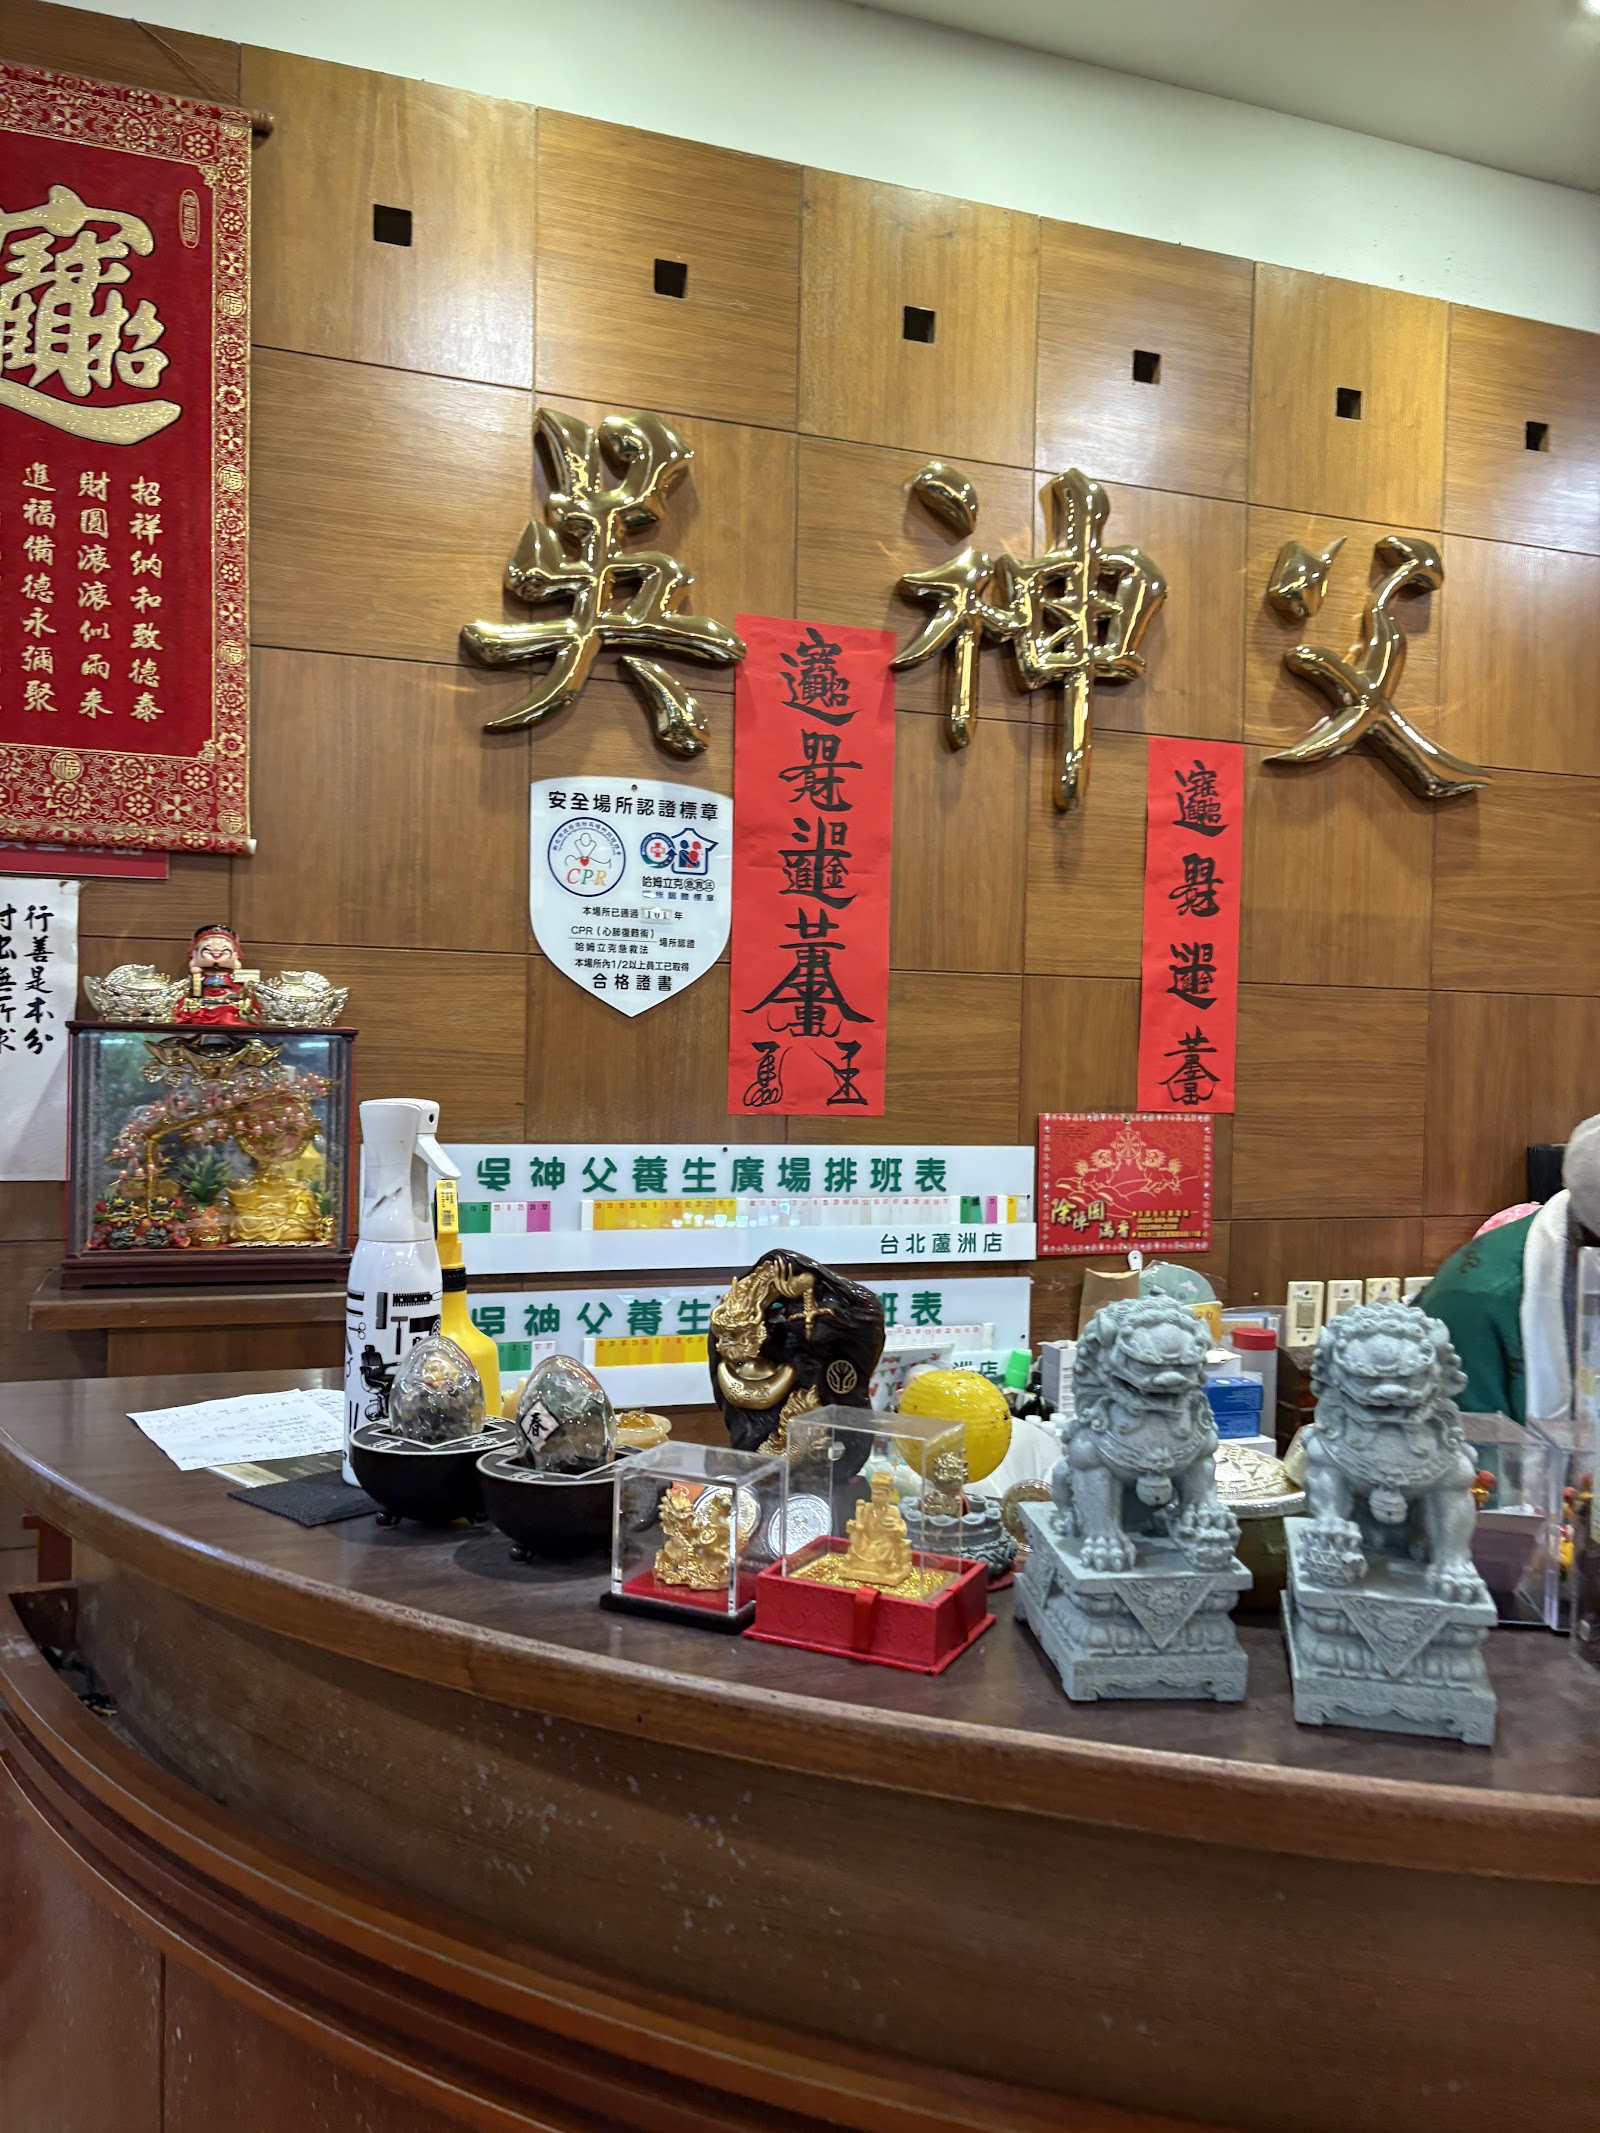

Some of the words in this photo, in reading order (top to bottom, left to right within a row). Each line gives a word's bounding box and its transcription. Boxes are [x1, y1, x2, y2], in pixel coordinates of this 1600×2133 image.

[460, 407, 1492, 811] 吳神父
[548, 791, 719, 821] 安全場所認證標章
[566, 868, 608, 887] CPR
[24, 905, 55, 1055] 行善是本分
[592, 973, 672, 992] 合格證書
[477, 1155, 947, 1193] 吳神父養生廣場排班表
[880, 1232, 1003, 1254] 台北蘆洲店
[526, 1412, 549, 1437] 春
